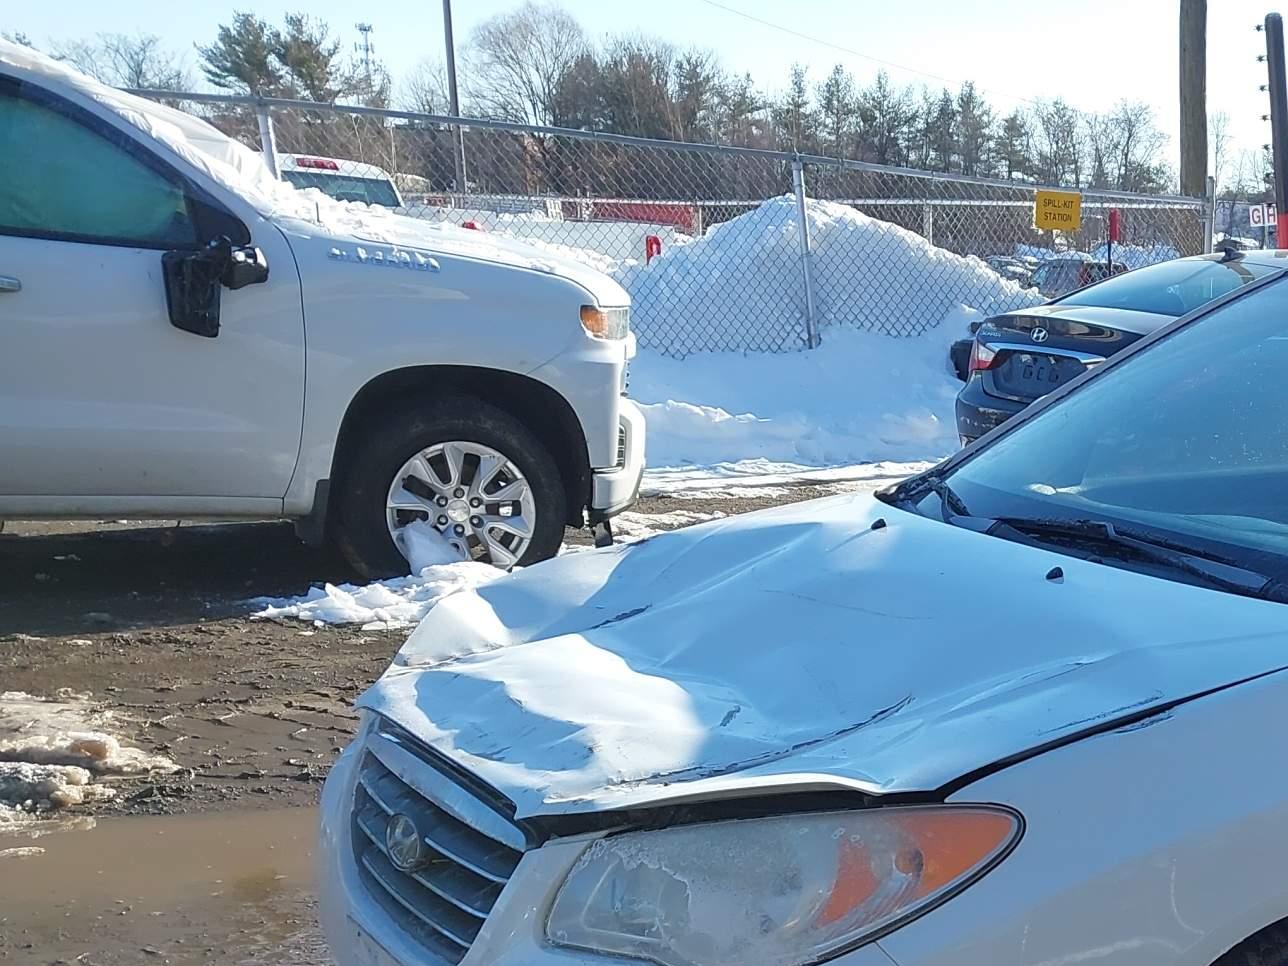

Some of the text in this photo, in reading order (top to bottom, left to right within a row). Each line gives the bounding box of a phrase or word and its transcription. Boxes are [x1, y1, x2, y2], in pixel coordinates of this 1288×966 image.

[1043, 198, 1074, 209] SPILL-KIT
[1044, 211, 1073, 222] STATION
[1251, 205, 1276, 225] G H
